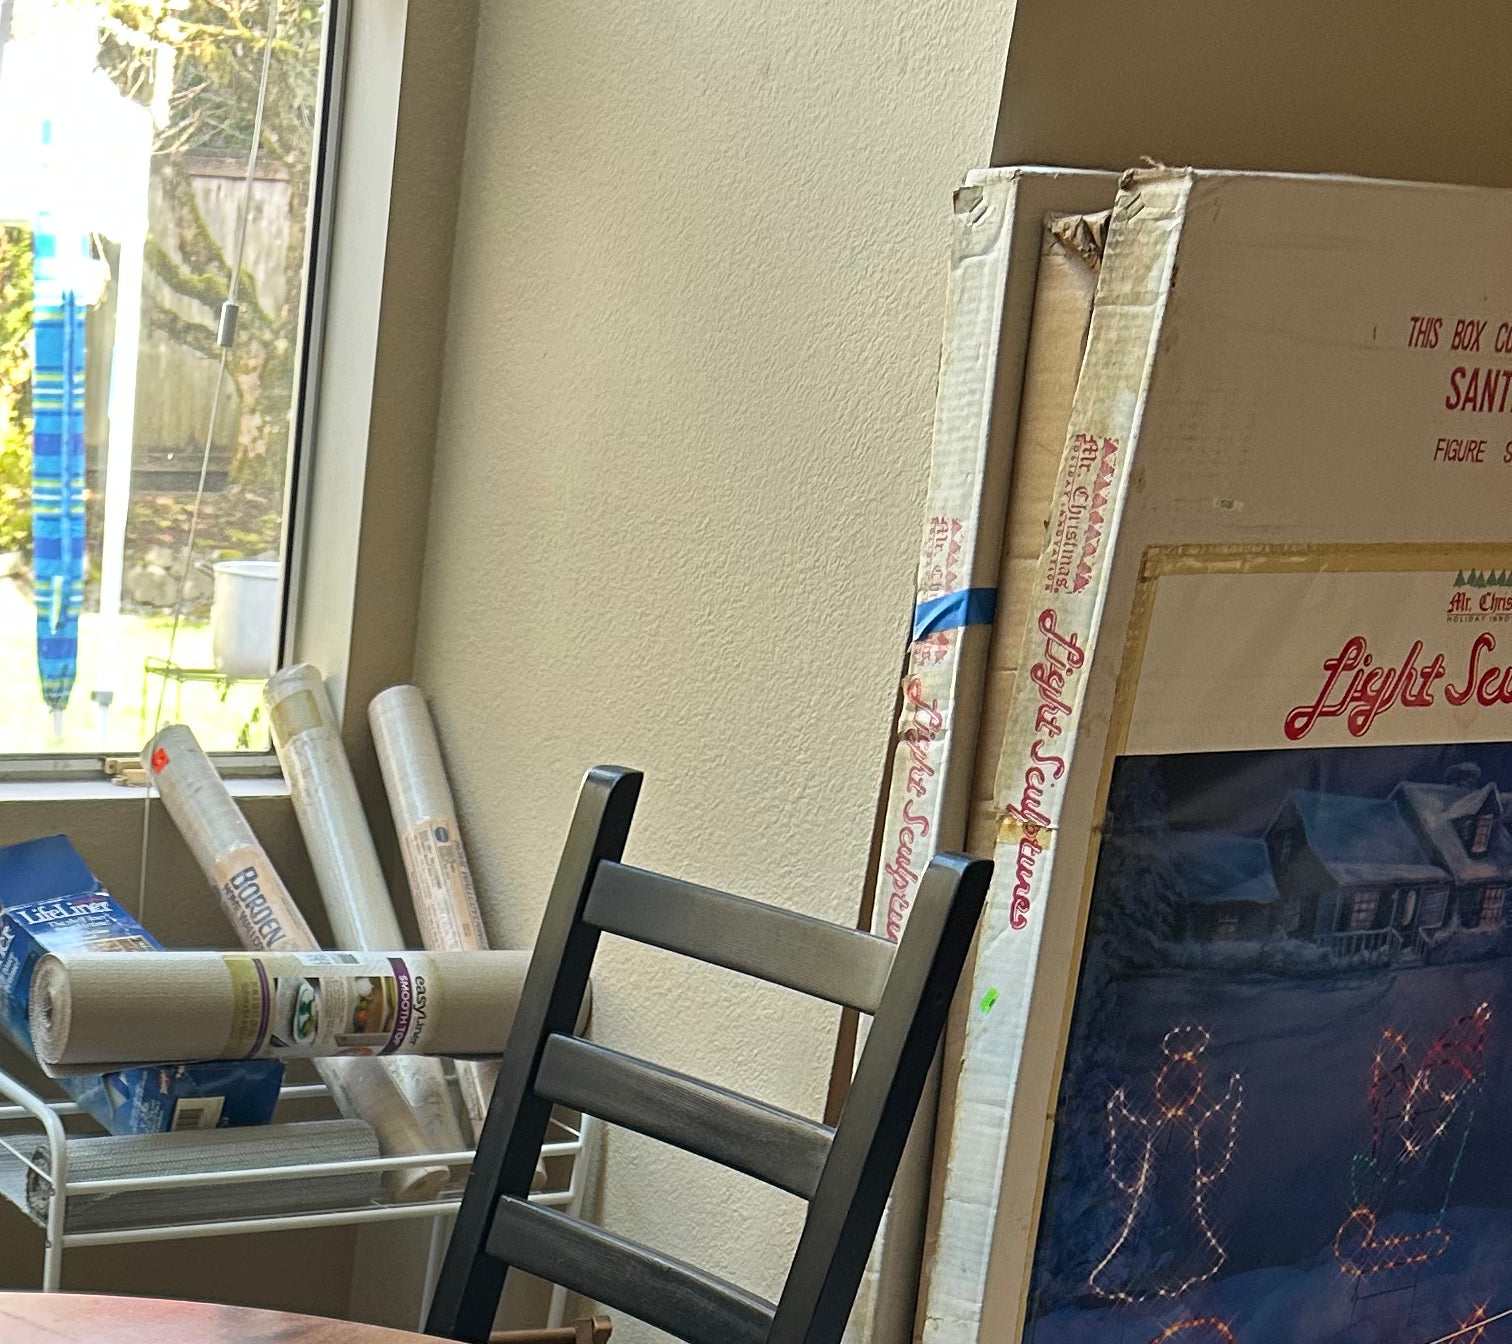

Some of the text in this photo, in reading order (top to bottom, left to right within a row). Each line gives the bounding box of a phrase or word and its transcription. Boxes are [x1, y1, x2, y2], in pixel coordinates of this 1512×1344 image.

[1407, 316, 1443, 350] THIS
[1449, 318, 1488, 352] BOX
[1445, 366, 1512, 413] SANT
[1433, 437, 1488, 463] FIGURE
[1284, 635, 1446, 741] Light
[1006, 608, 1086, 931] Light Sculptures
[17, 900, 114, 926] LifeLiner
[230, 866, 287, 948] BORDEN
[398, 974, 411, 1024] SMOOTH
